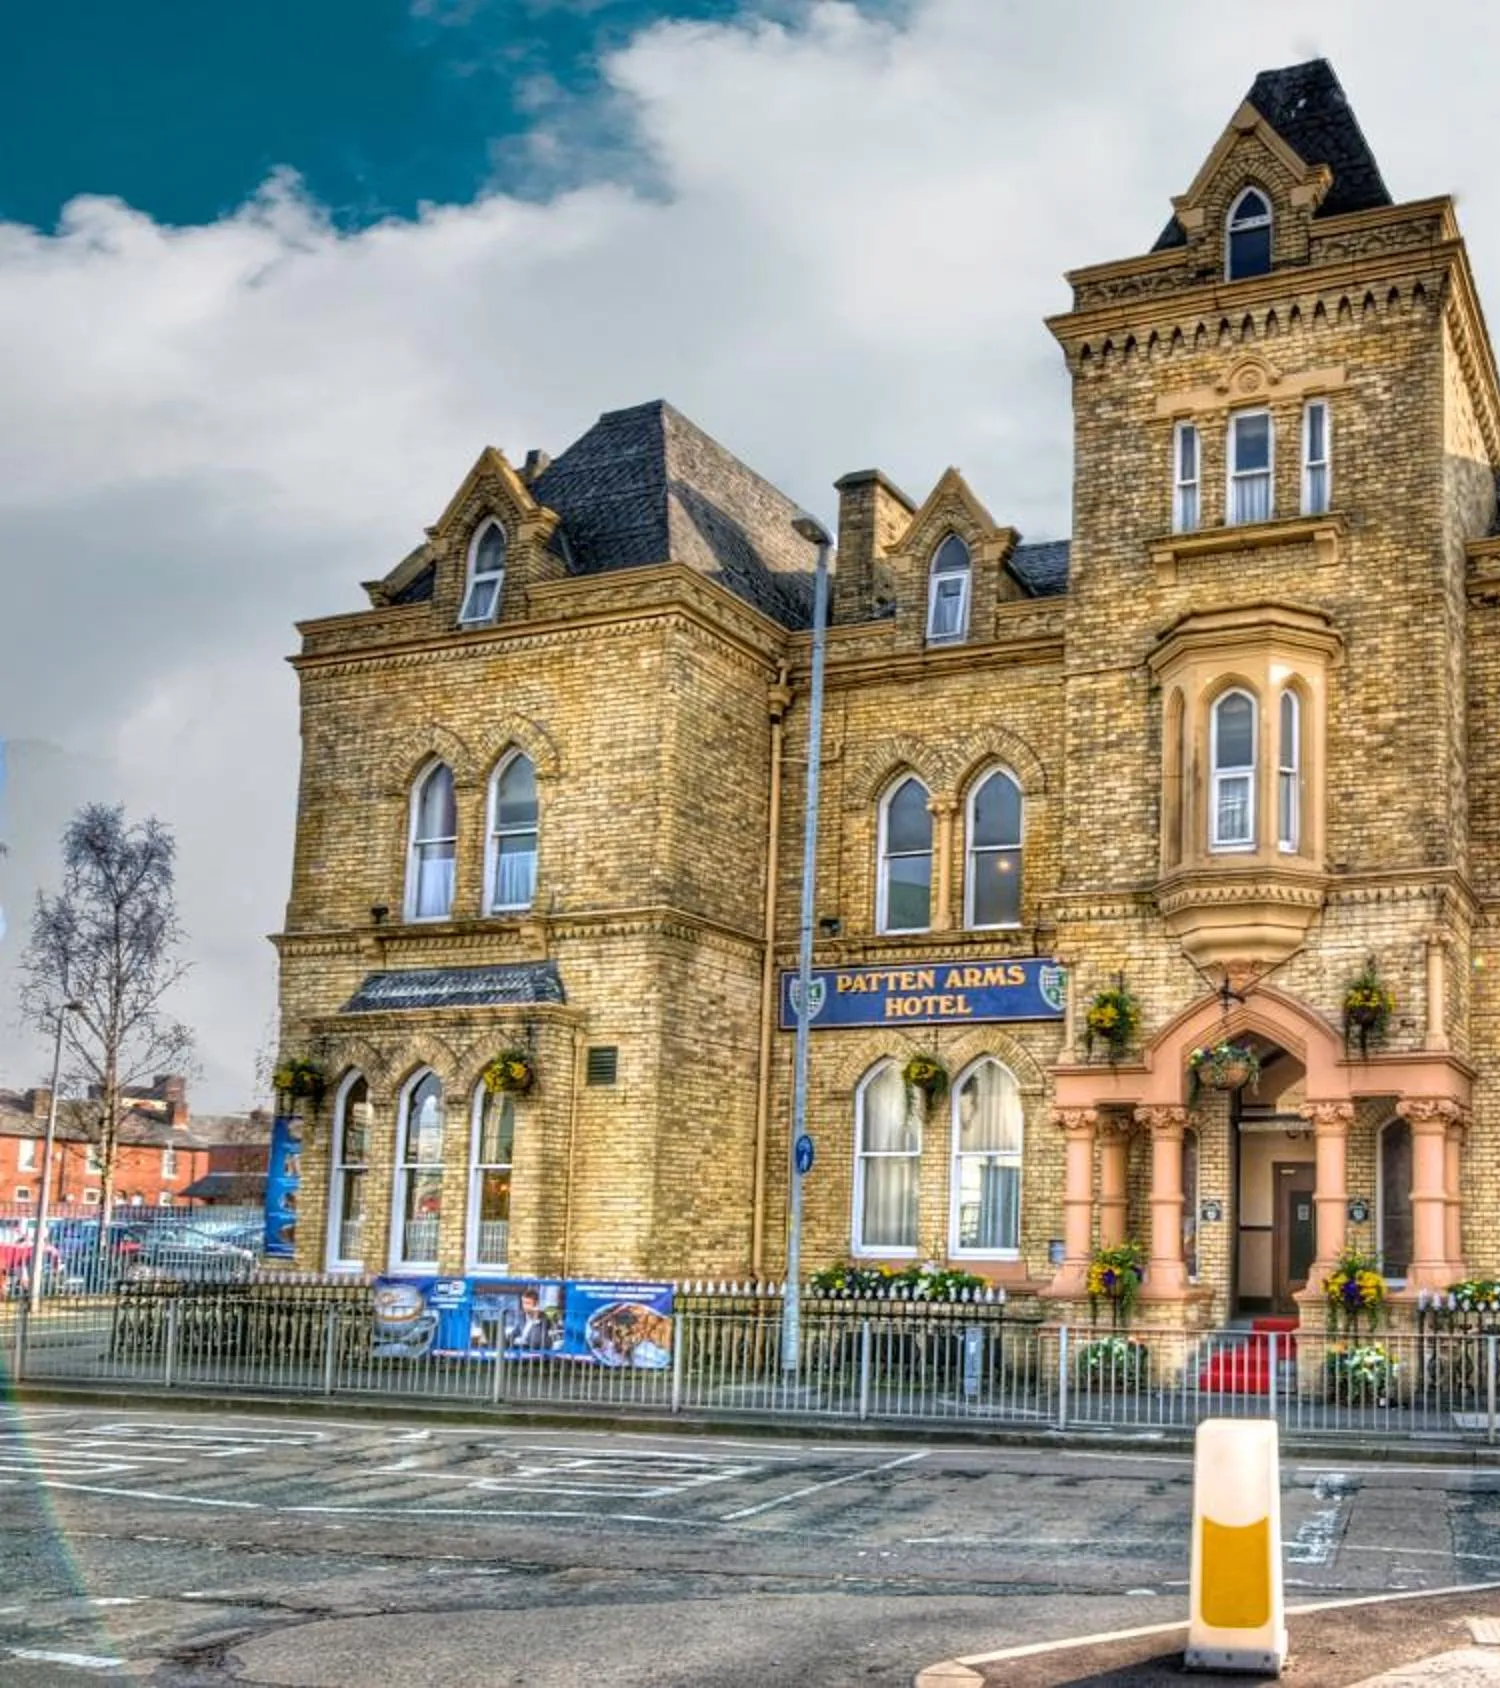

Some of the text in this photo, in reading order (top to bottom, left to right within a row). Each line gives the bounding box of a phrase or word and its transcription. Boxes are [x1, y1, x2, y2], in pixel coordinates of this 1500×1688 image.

[836, 965, 1026, 993] PATTEN ARMS
[884, 994, 972, 1017] HOTEL
